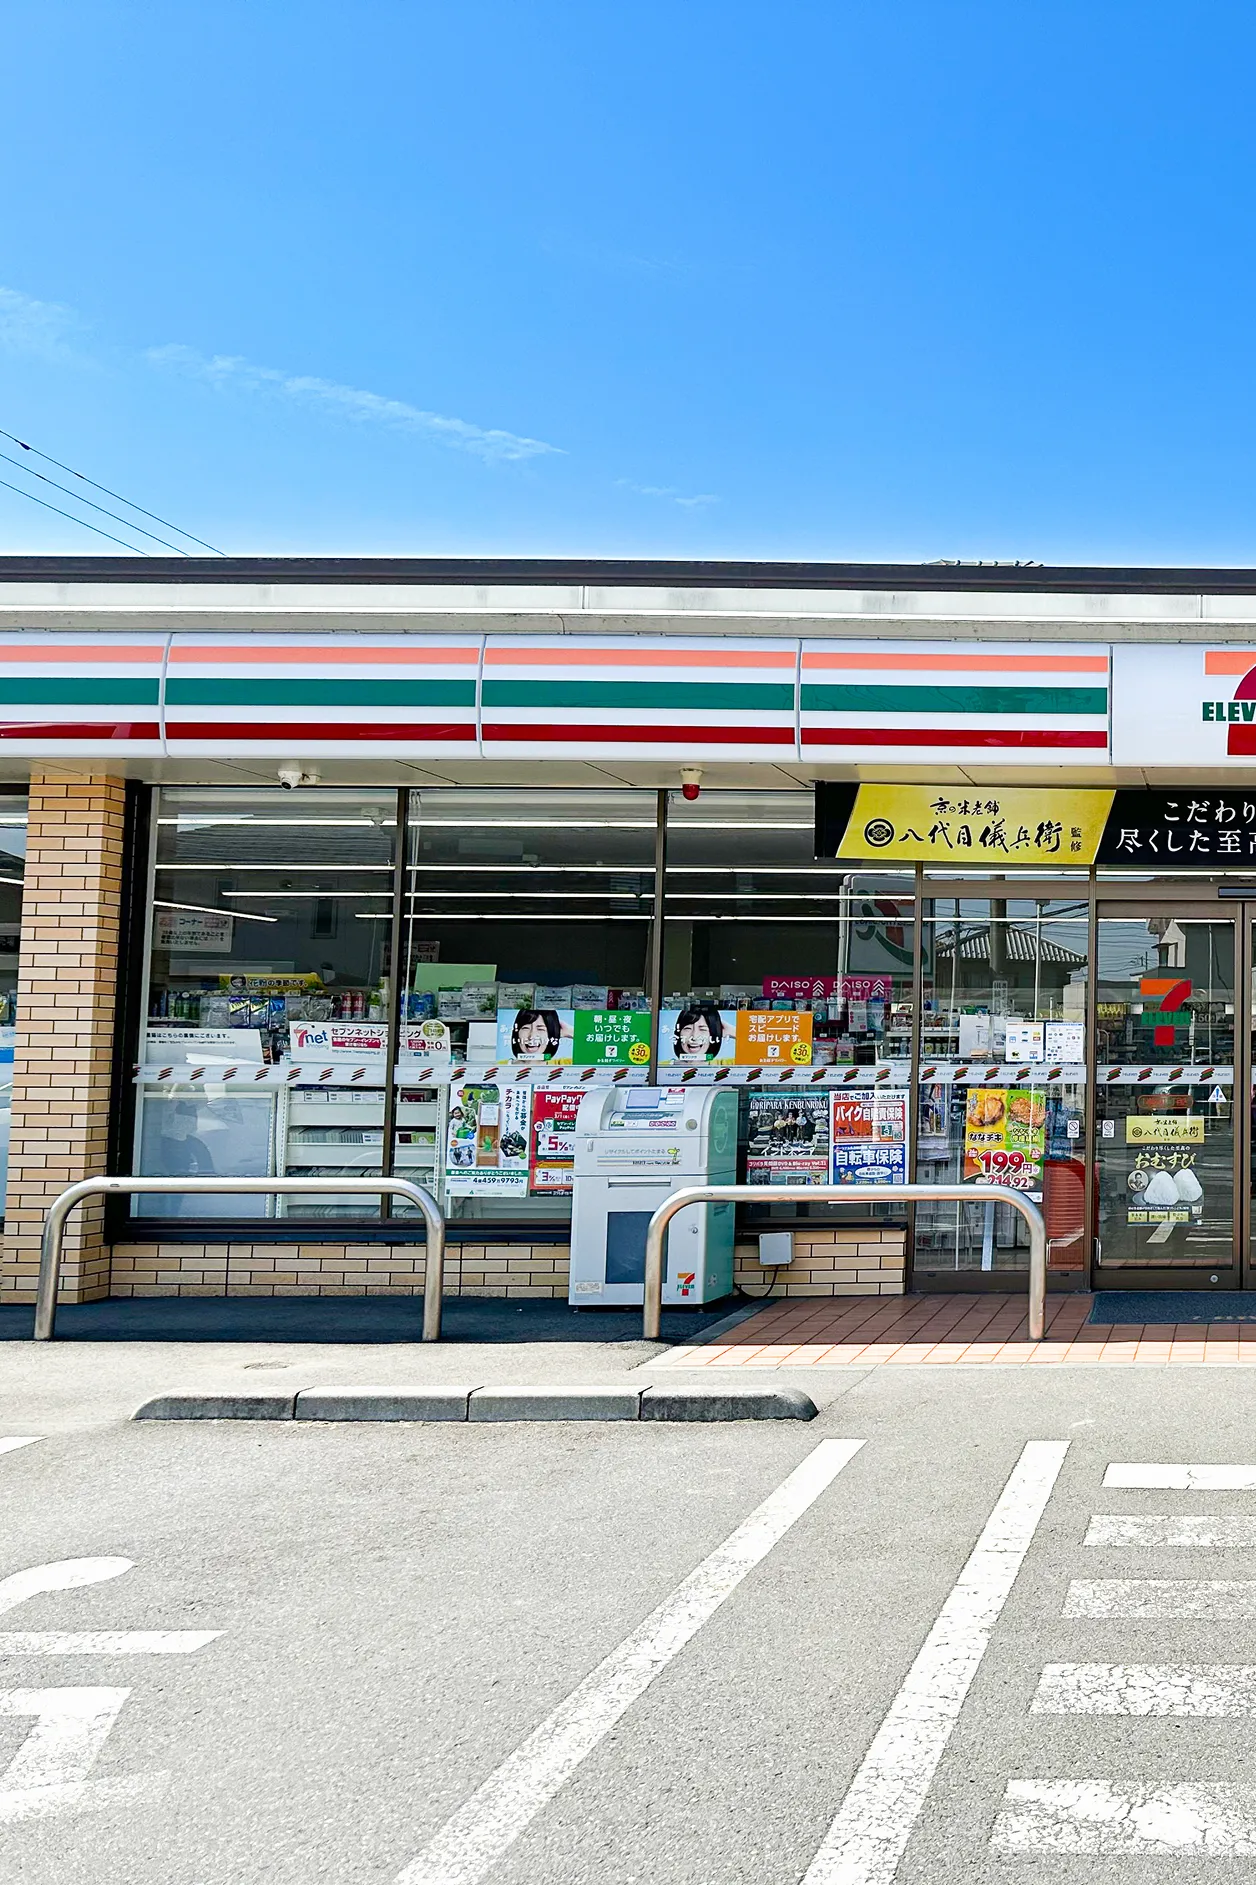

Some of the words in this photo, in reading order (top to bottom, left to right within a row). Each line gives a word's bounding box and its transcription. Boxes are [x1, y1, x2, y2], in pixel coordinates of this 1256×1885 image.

[930, 797, 1000, 816] 京の米老舗
[1164, 800, 1256, 824] こだわり
[899, 817, 1063, 854] 八代目儀兵衛
[1070, 827, 1082, 852] 監修
[771, 980, 810, 989] DAISO
[833, 980, 871, 989] DAISO
[749, 1014, 799, 1023] 宅配アプリで
[595, 1024, 630, 1033] いつでも
[586, 1033, 640, 1043] お届けします。
[748, 1033, 801, 1043] お届けします。
[548, 1136, 568, 1151] 5%
[970, 1133, 1002, 1142] ななチキ
[836, 1149, 903, 1167] 自転車保険
[1135, 1151, 1197, 1169] おむすび
